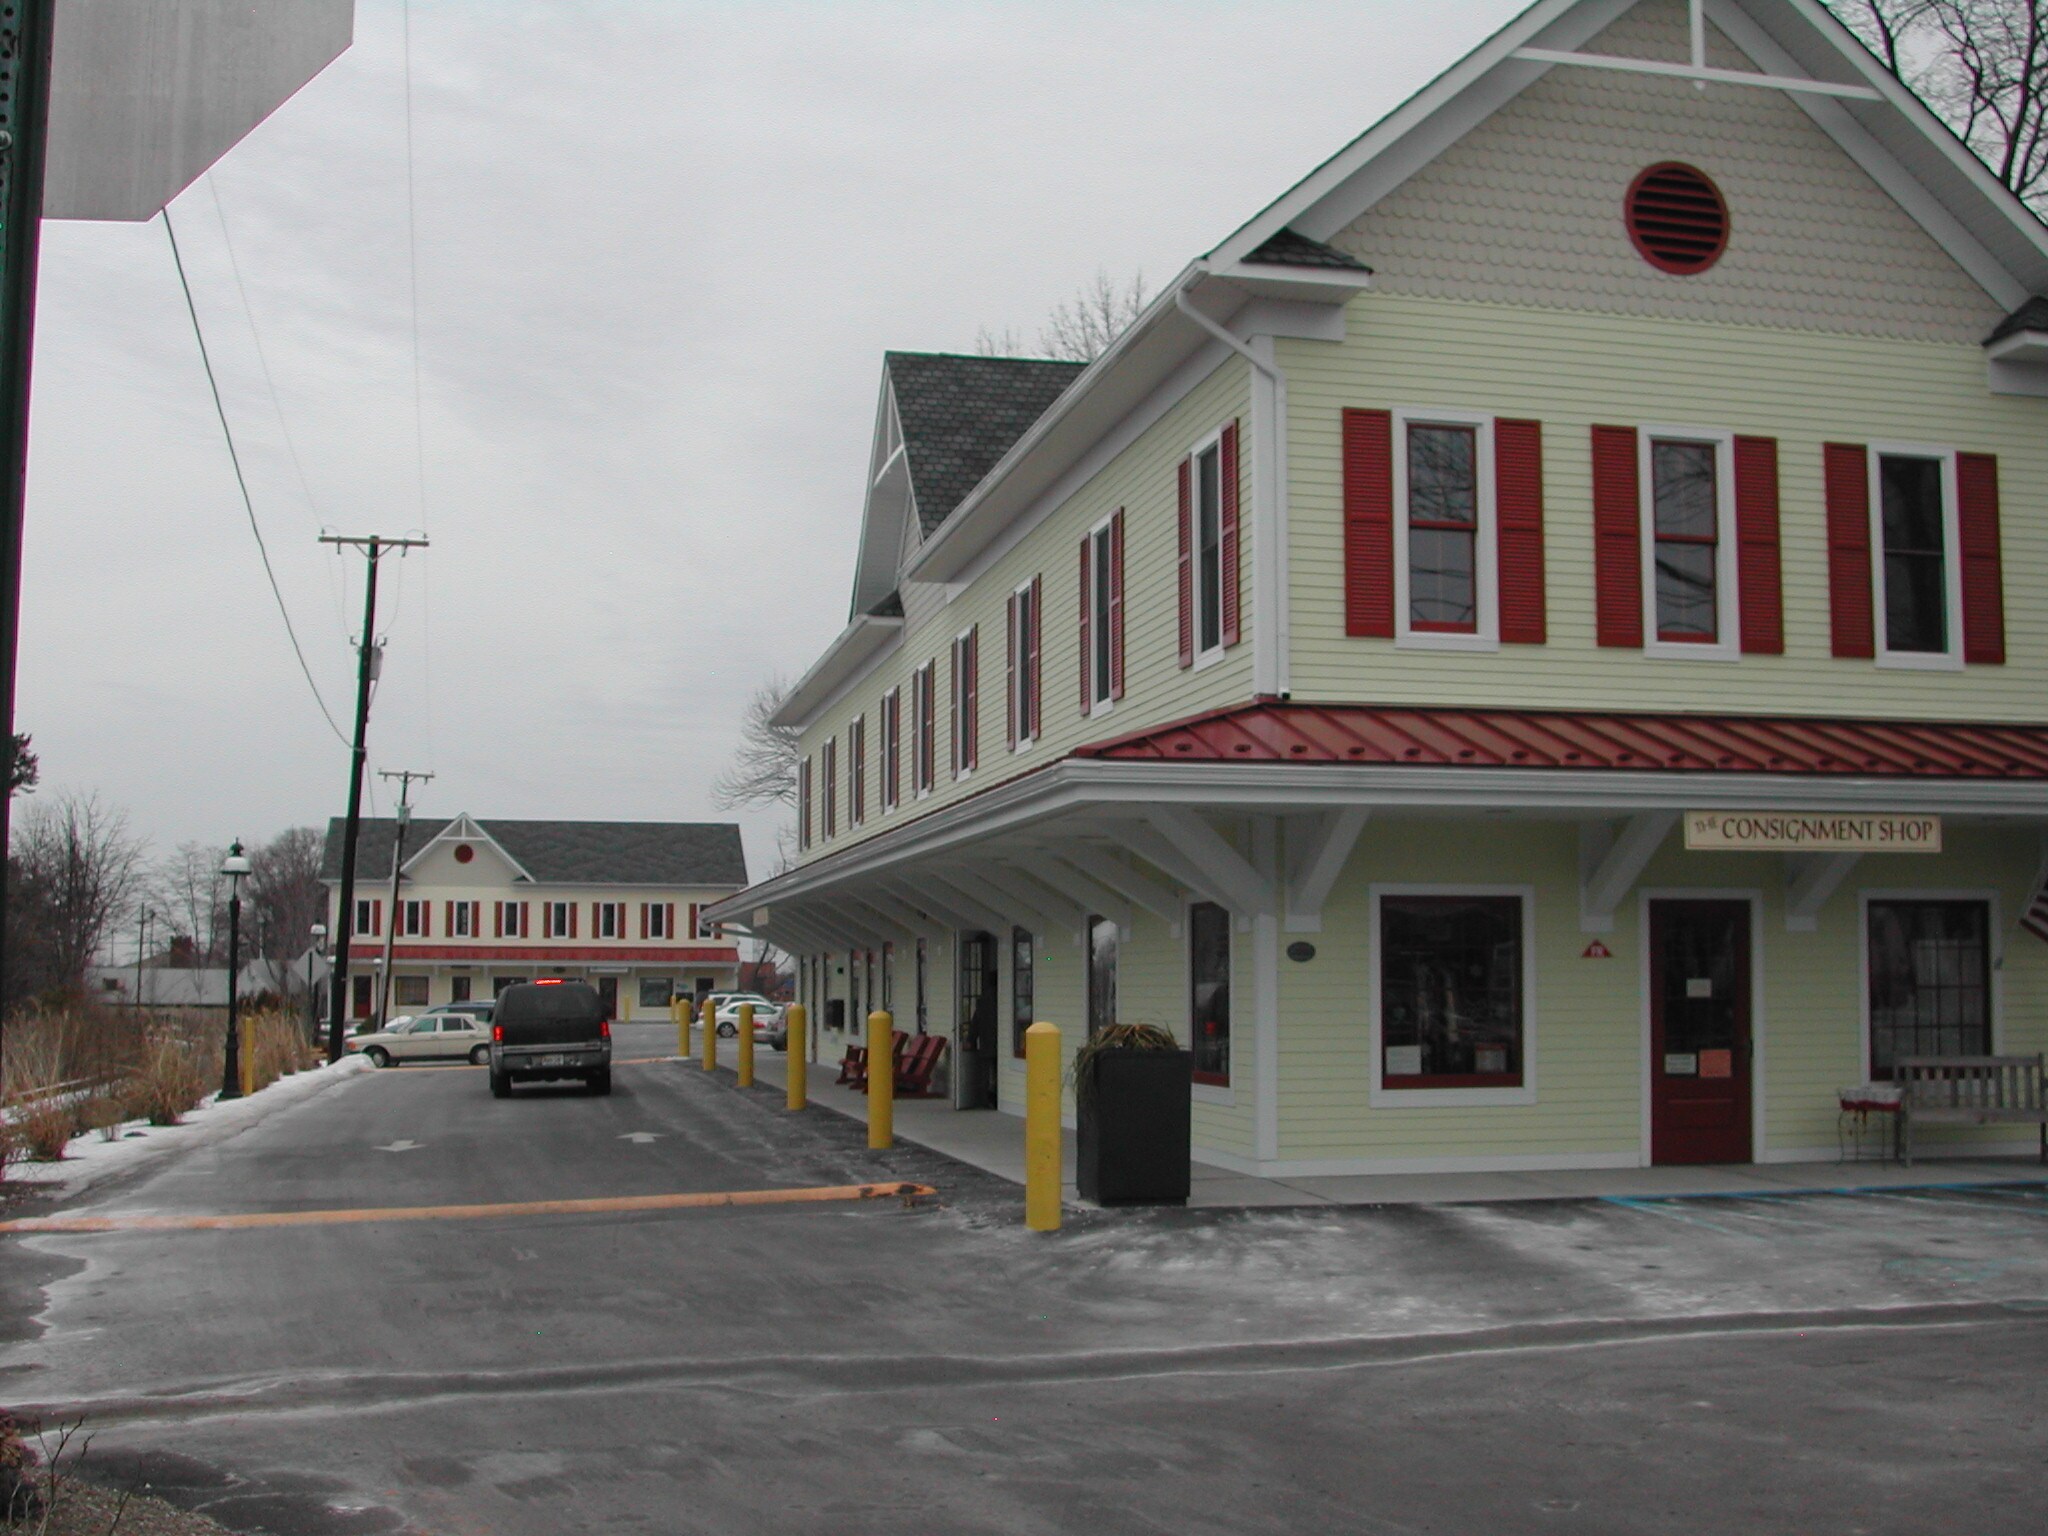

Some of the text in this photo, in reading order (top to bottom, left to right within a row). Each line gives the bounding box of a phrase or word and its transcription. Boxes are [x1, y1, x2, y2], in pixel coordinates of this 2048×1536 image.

[1695, 816, 1933, 842] THE CONSIGNMENT SHOP
